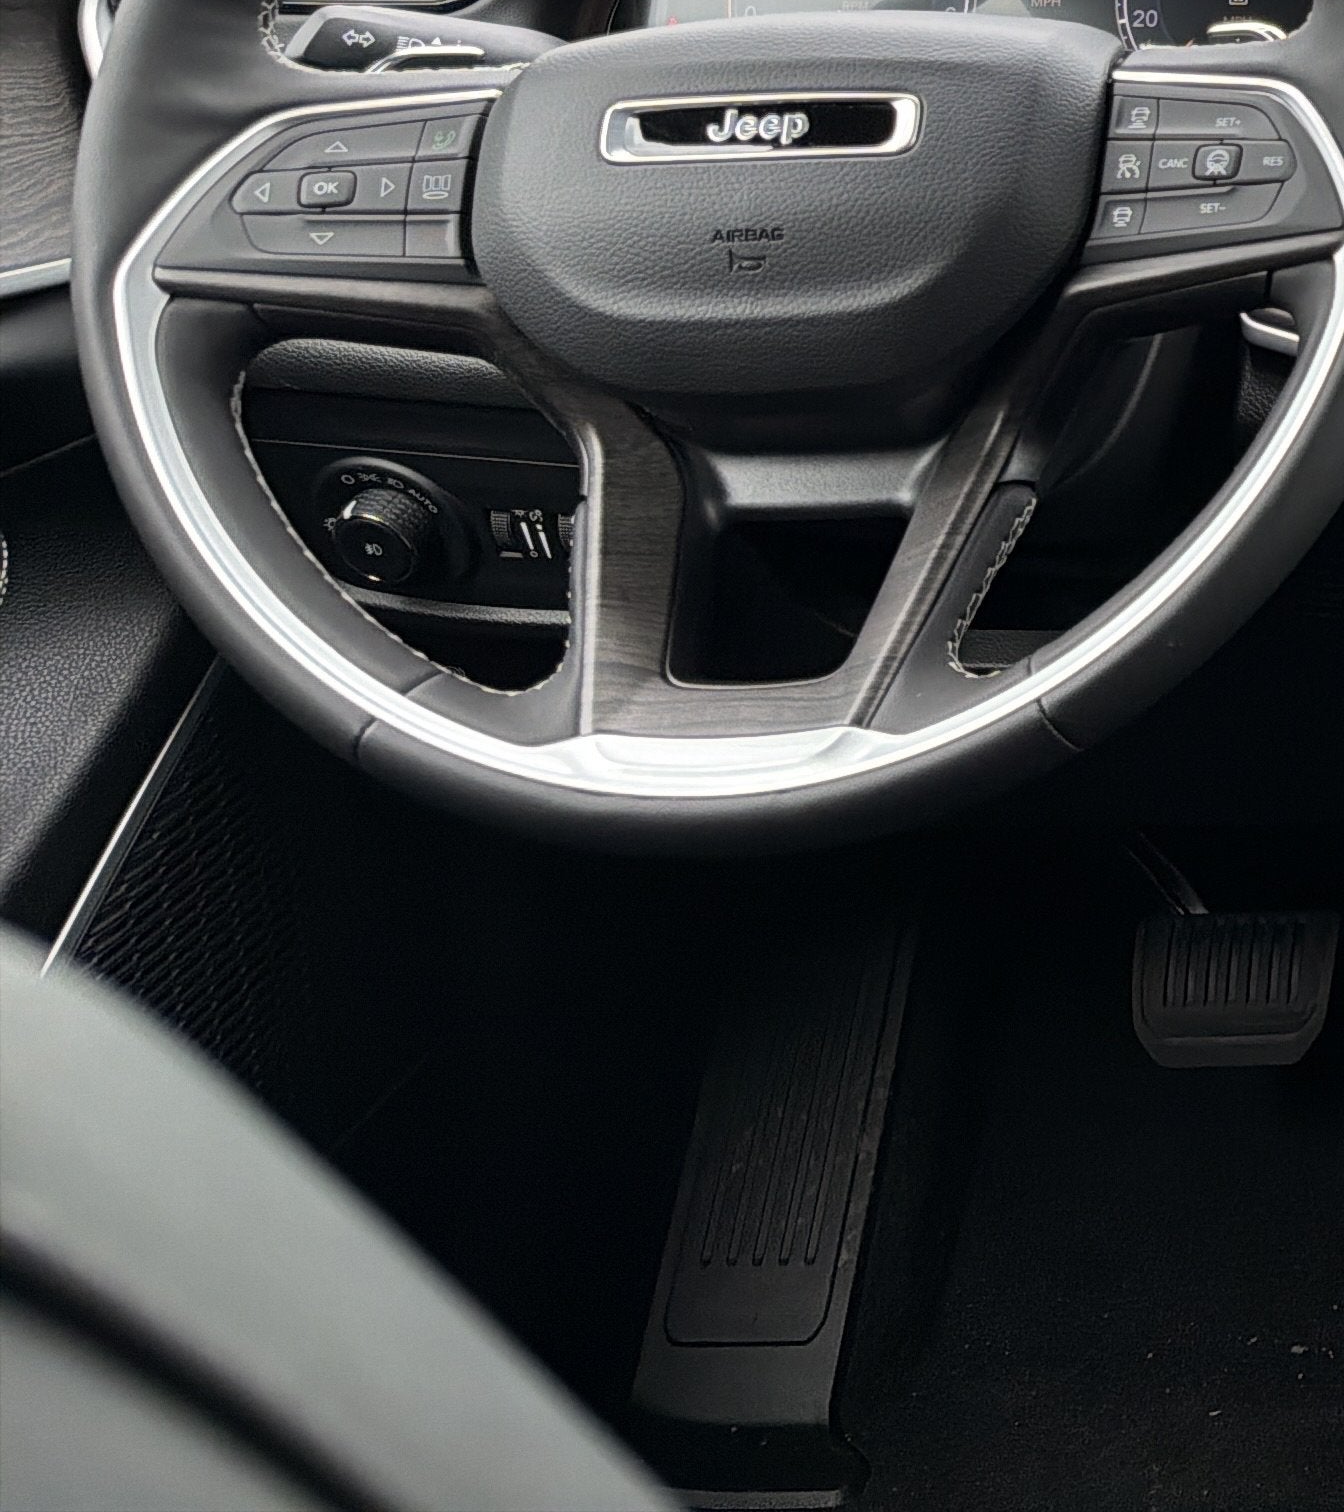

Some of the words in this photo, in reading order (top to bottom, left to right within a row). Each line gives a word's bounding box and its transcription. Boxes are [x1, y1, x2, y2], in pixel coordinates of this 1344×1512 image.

[1132, 9, 1158, 28] 20
[706, 108, 810, 145] Jeep
[1158, 158, 1189, 169] CANC
[1262, 156, 1284, 167] RES
[313, 182, 338, 195] OK
[711, 228, 785, 243] AIRBAG
[409, 489, 438, 514] AUTO
